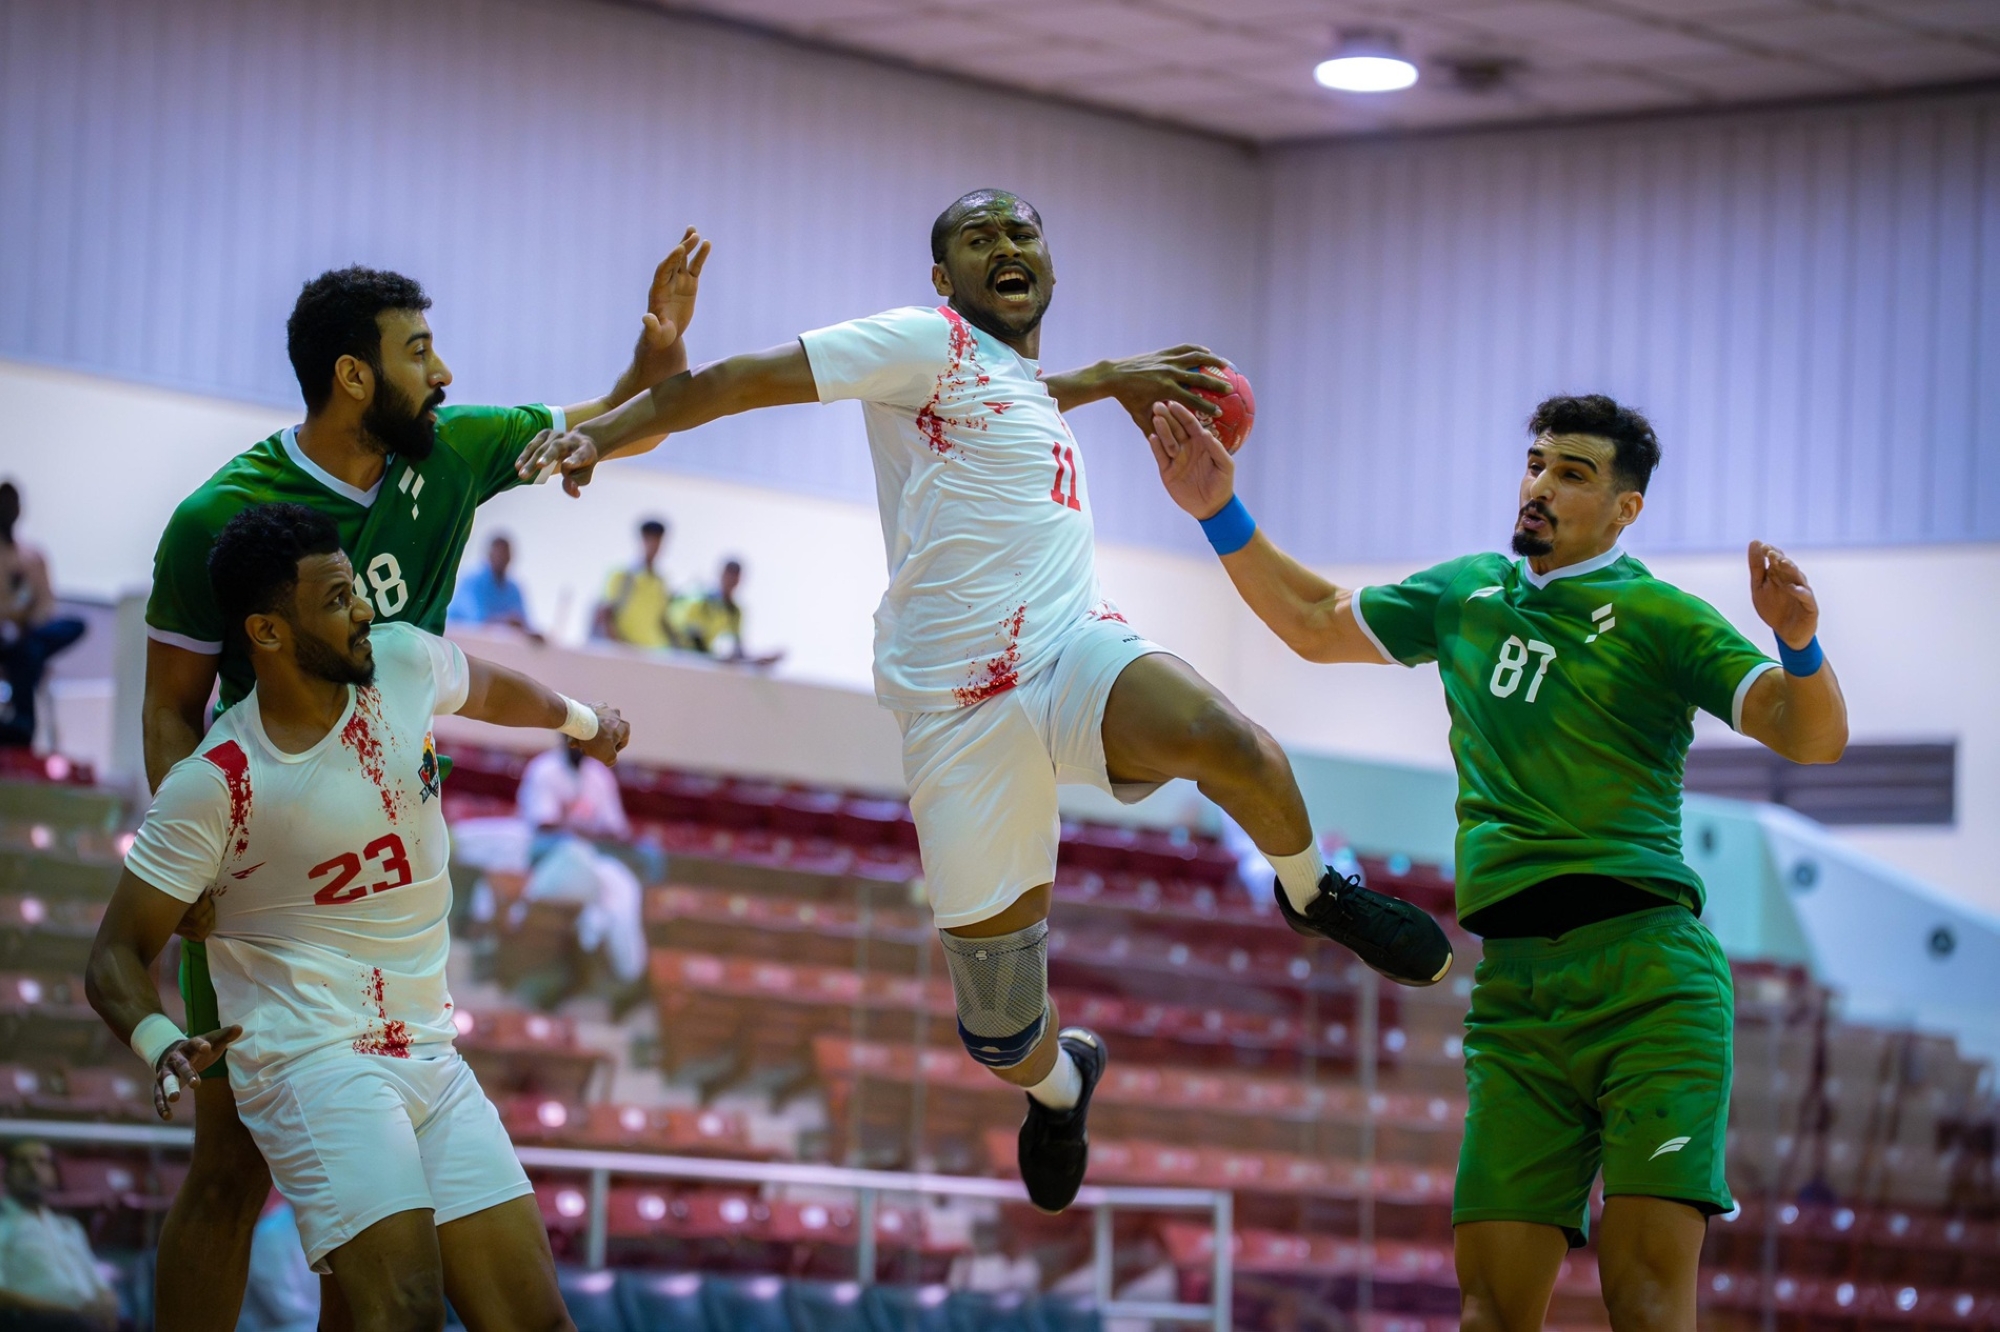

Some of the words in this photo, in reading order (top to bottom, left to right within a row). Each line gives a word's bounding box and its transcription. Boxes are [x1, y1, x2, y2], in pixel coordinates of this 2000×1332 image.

[1051, 441, 1081, 512] 11
[1489, 634, 1557, 703] 87
[308, 832, 412, 905] 23
